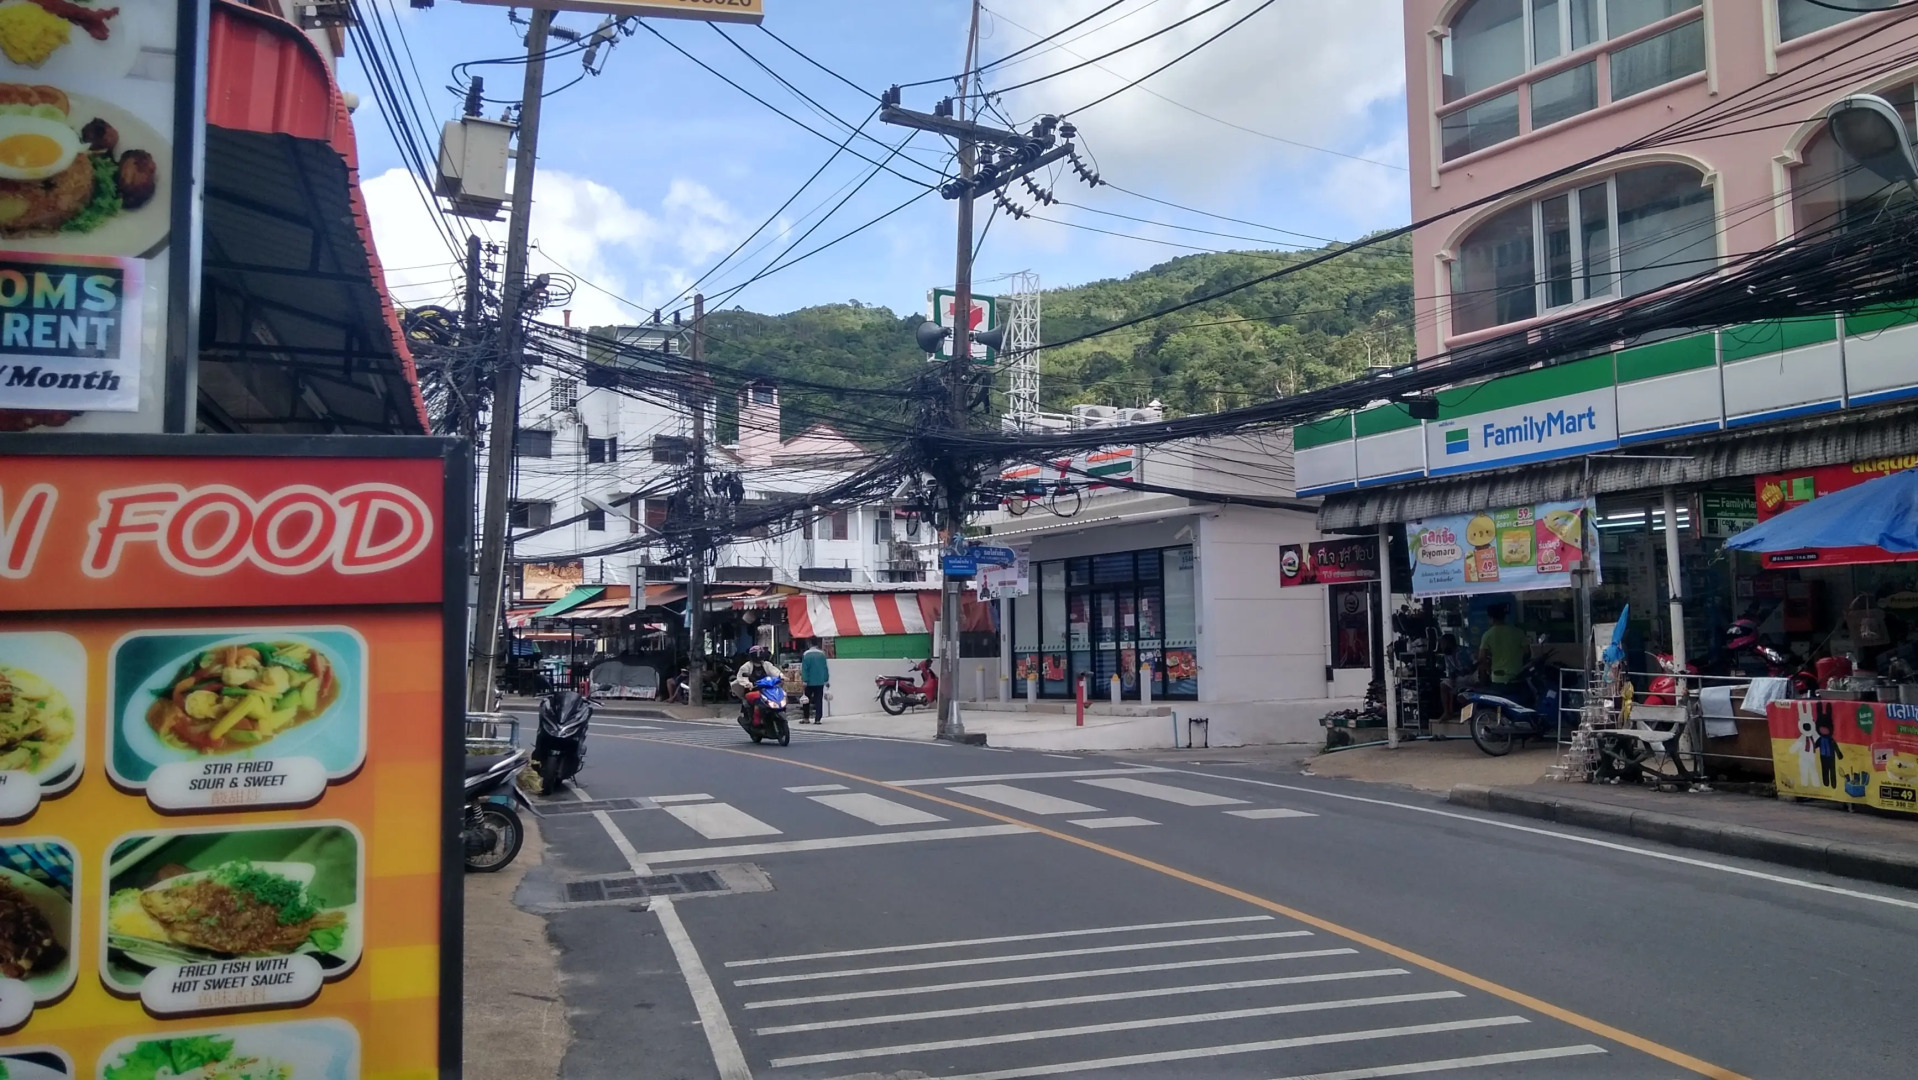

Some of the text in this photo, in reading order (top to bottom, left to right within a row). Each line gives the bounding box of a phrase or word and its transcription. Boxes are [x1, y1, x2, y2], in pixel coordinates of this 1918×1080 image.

[0, 269, 116, 312] OMS
[2, 312, 115, 351] RENT
[1483, 406, 1595, 449] FamilyMart
[82, 482, 434, 578] FOOD
[189, 774, 287, 791] SOUR & SWEET
[203, 761, 273, 775] STIR FRIED
[171, 972, 295, 993] HOT SWEET SAUCE
[179, 958, 288, 978] FRIED FISH WITH
